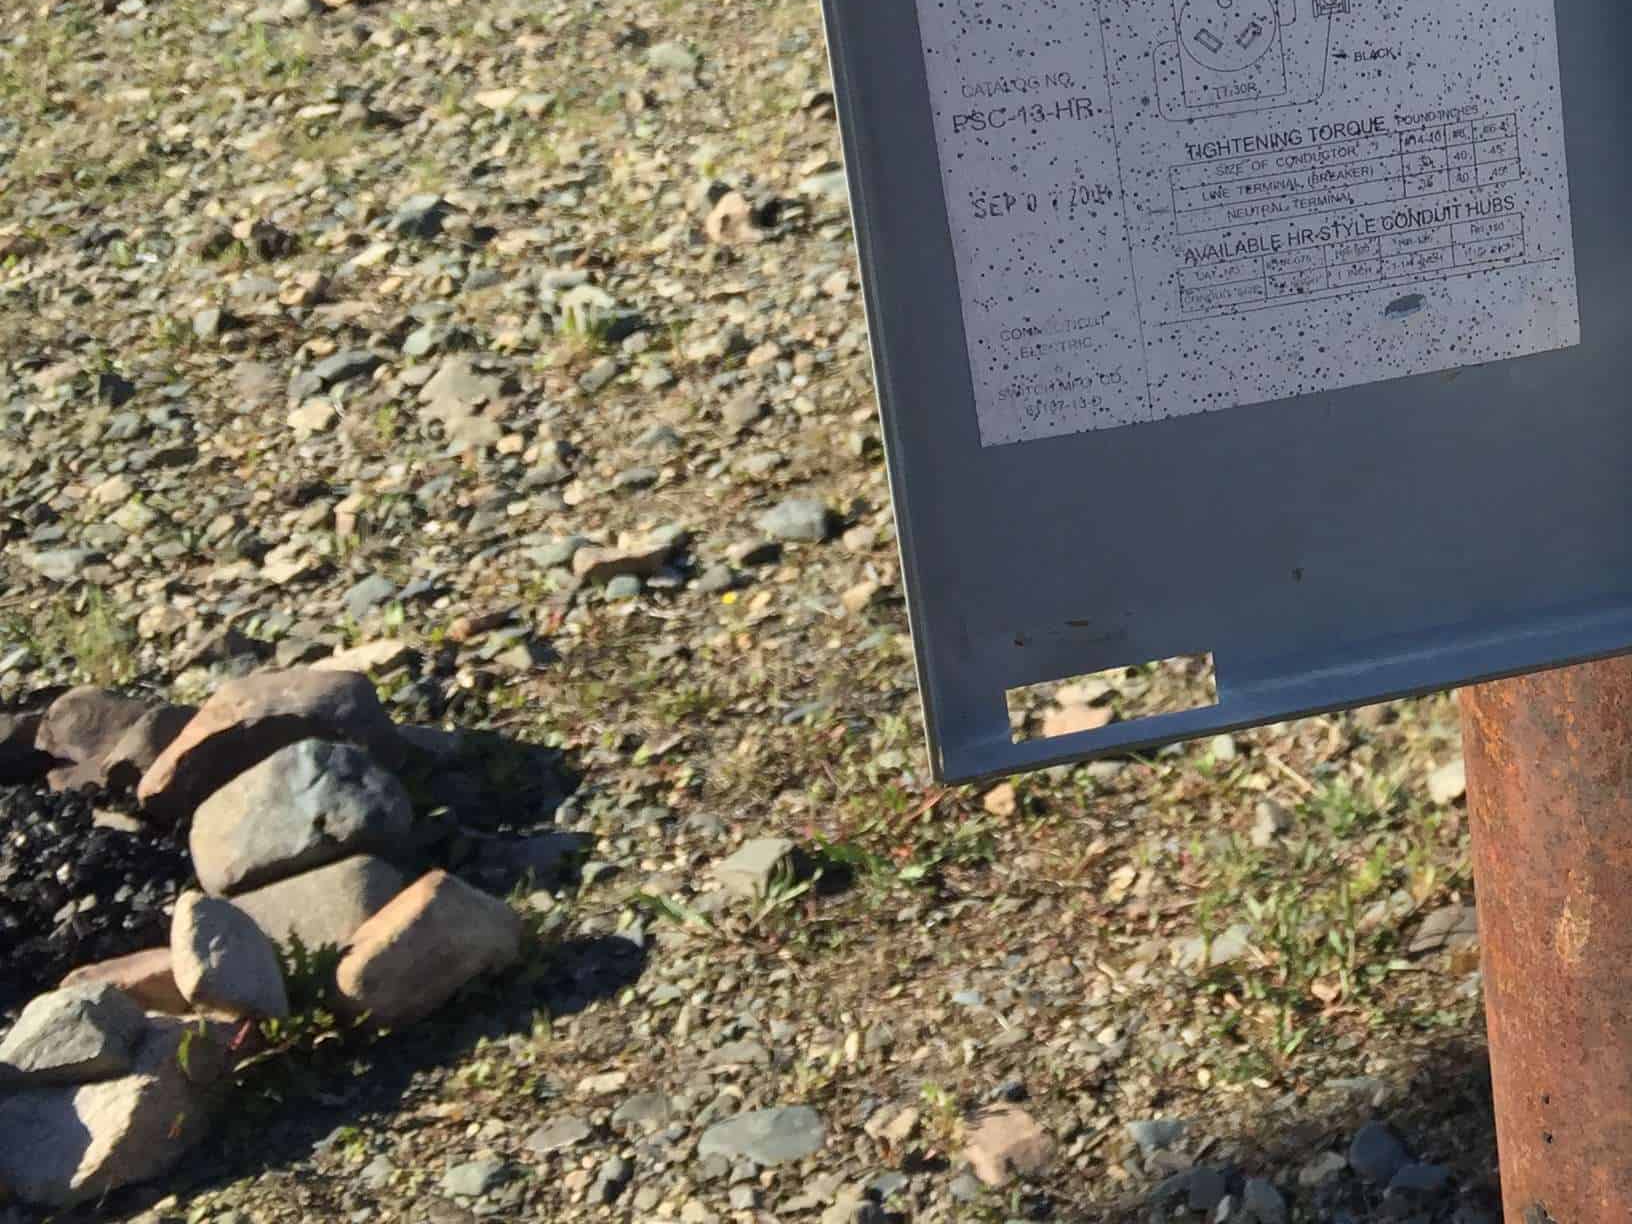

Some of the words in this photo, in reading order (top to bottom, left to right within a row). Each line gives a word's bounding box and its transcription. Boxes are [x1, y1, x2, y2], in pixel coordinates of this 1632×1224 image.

[1353, 45, 1393, 63] BLACK
[960, 73, 1041, 98] CATALOG
[952, 95, 1094, 134] PSC-13-HR
[1186, 128, 1303, 160] TIGHTENING
[1307, 114, 1386, 143] TORQUE
[1250, 159, 1268, 171] OF
[1275, 145, 1357, 169] CONDUCTOR
[971, 192, 1018, 220] SEP
[1182, 233, 1283, 264] AVAILABLE
[1287, 217, 1377, 248] HR-STYLE
[1380, 203, 1463, 233] CONDUIT
[1465, 194, 1515, 218] HUBS
